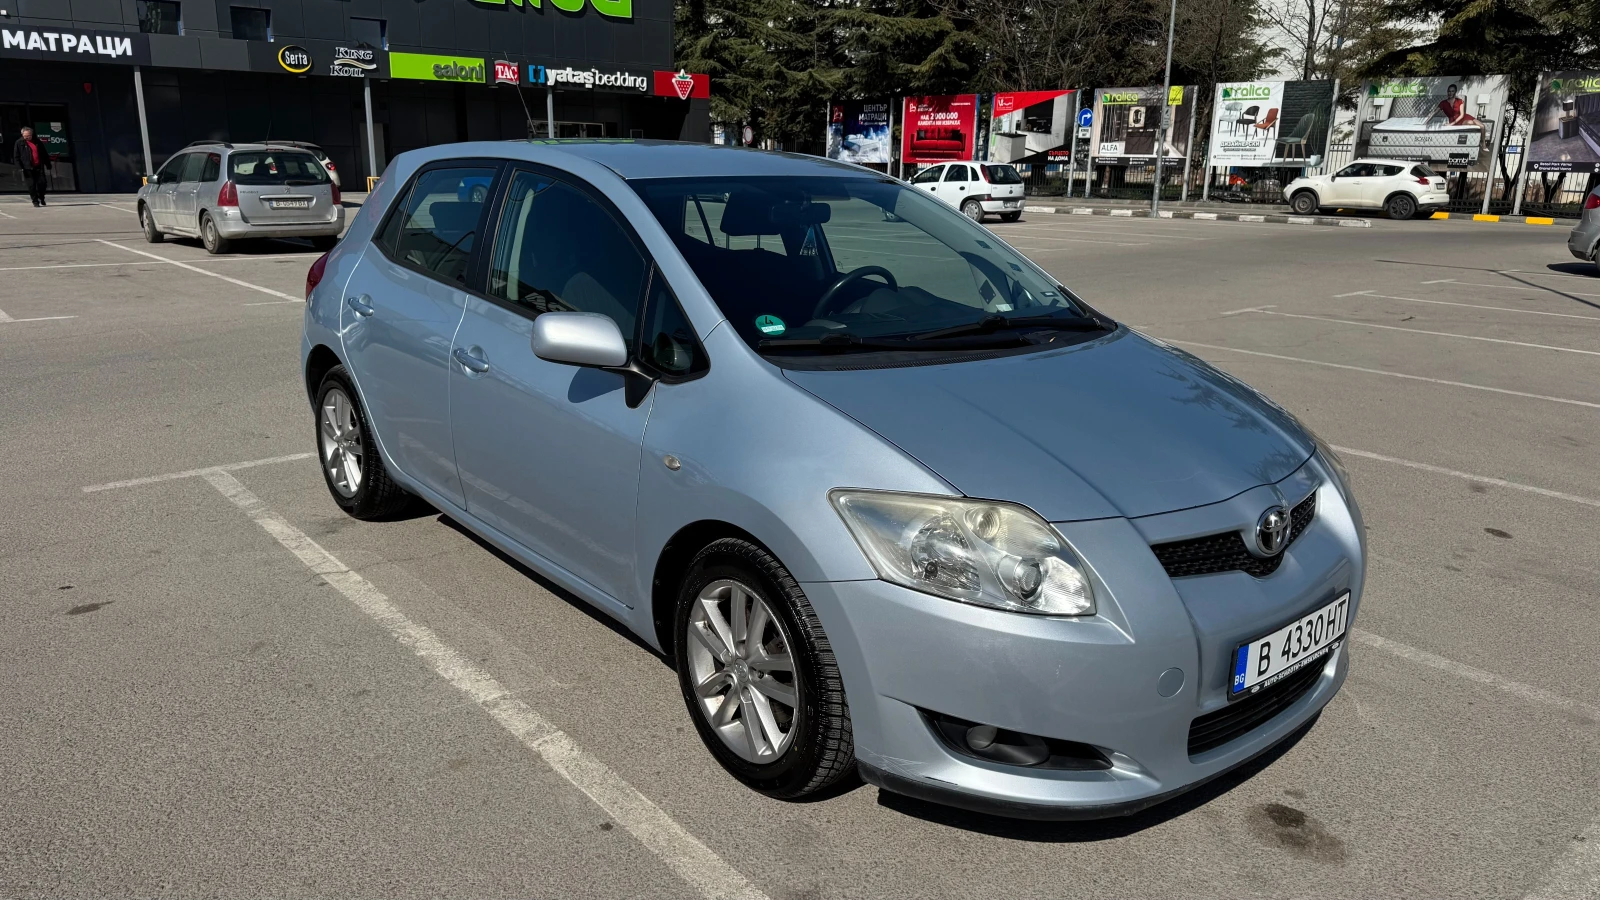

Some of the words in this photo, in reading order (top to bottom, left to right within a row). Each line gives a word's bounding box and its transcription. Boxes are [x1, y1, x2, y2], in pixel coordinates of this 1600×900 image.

[2, 30, 132, 58] МАТРАЦИ
[285, 51, 308, 65] Serta
[335, 46, 373, 60] KING
[330, 65, 364, 77] KOIL
[433, 61, 484, 81] saloni
[496, 65, 518, 79] TAC
[594, 70, 647, 91] bedding
[1111, 92, 1138, 101] ralica
[1232, 84, 1270, 97] ralica
[864, 104, 888, 112] ЦЕНТЪР
[859, 113, 887, 121] МАТРАЦИ
[1257, 641, 1271, 677] B
[1234, 673, 1245, 685] BG
